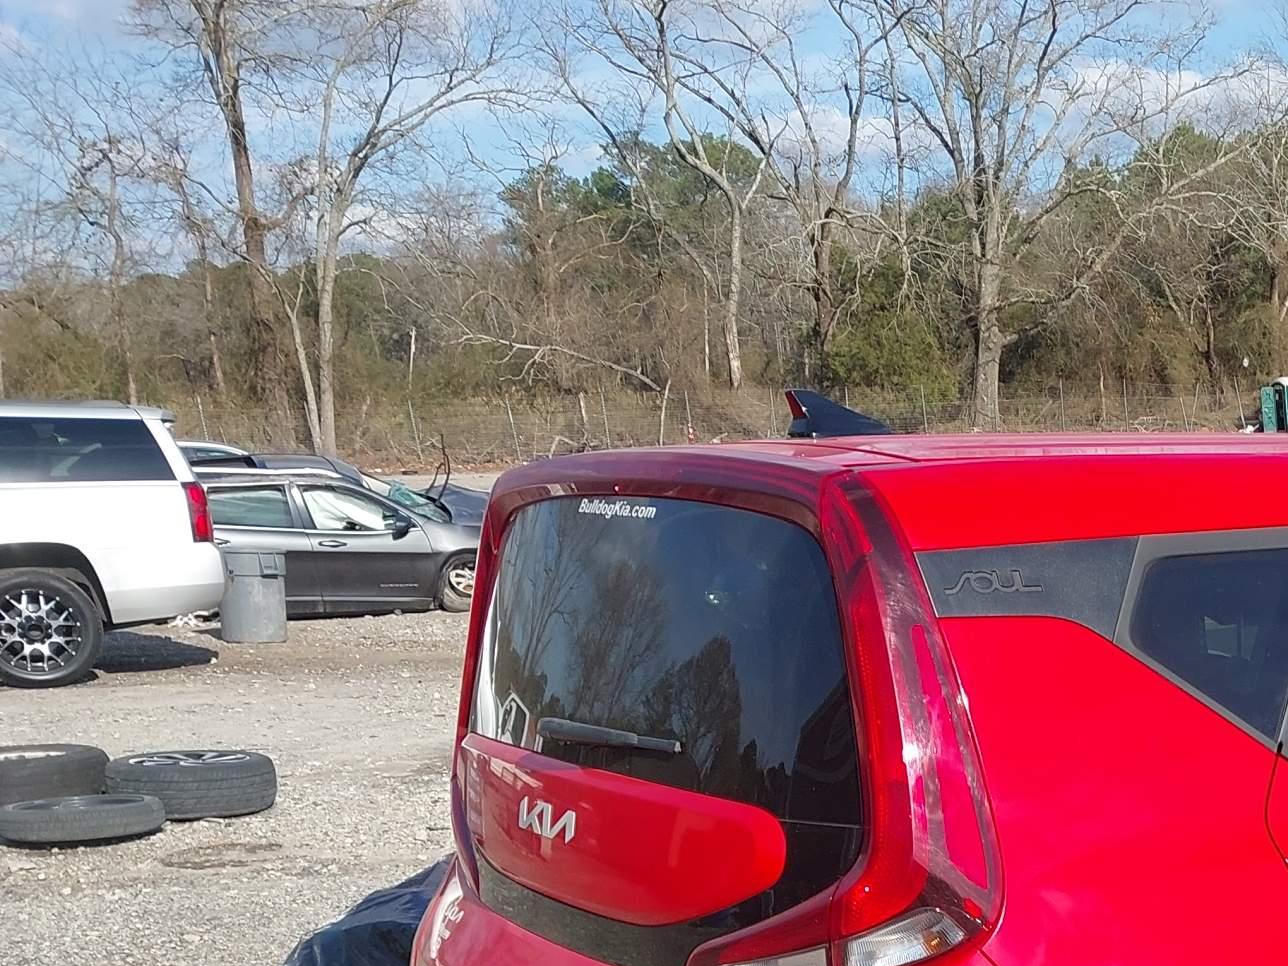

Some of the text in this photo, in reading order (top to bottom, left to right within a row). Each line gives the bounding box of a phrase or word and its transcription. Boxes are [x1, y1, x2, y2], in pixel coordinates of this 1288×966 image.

[578, 498, 657, 519] BulldogKia.com
[943, 569, 1044, 595] SOUL
[518, 795, 577, 844] KIA
